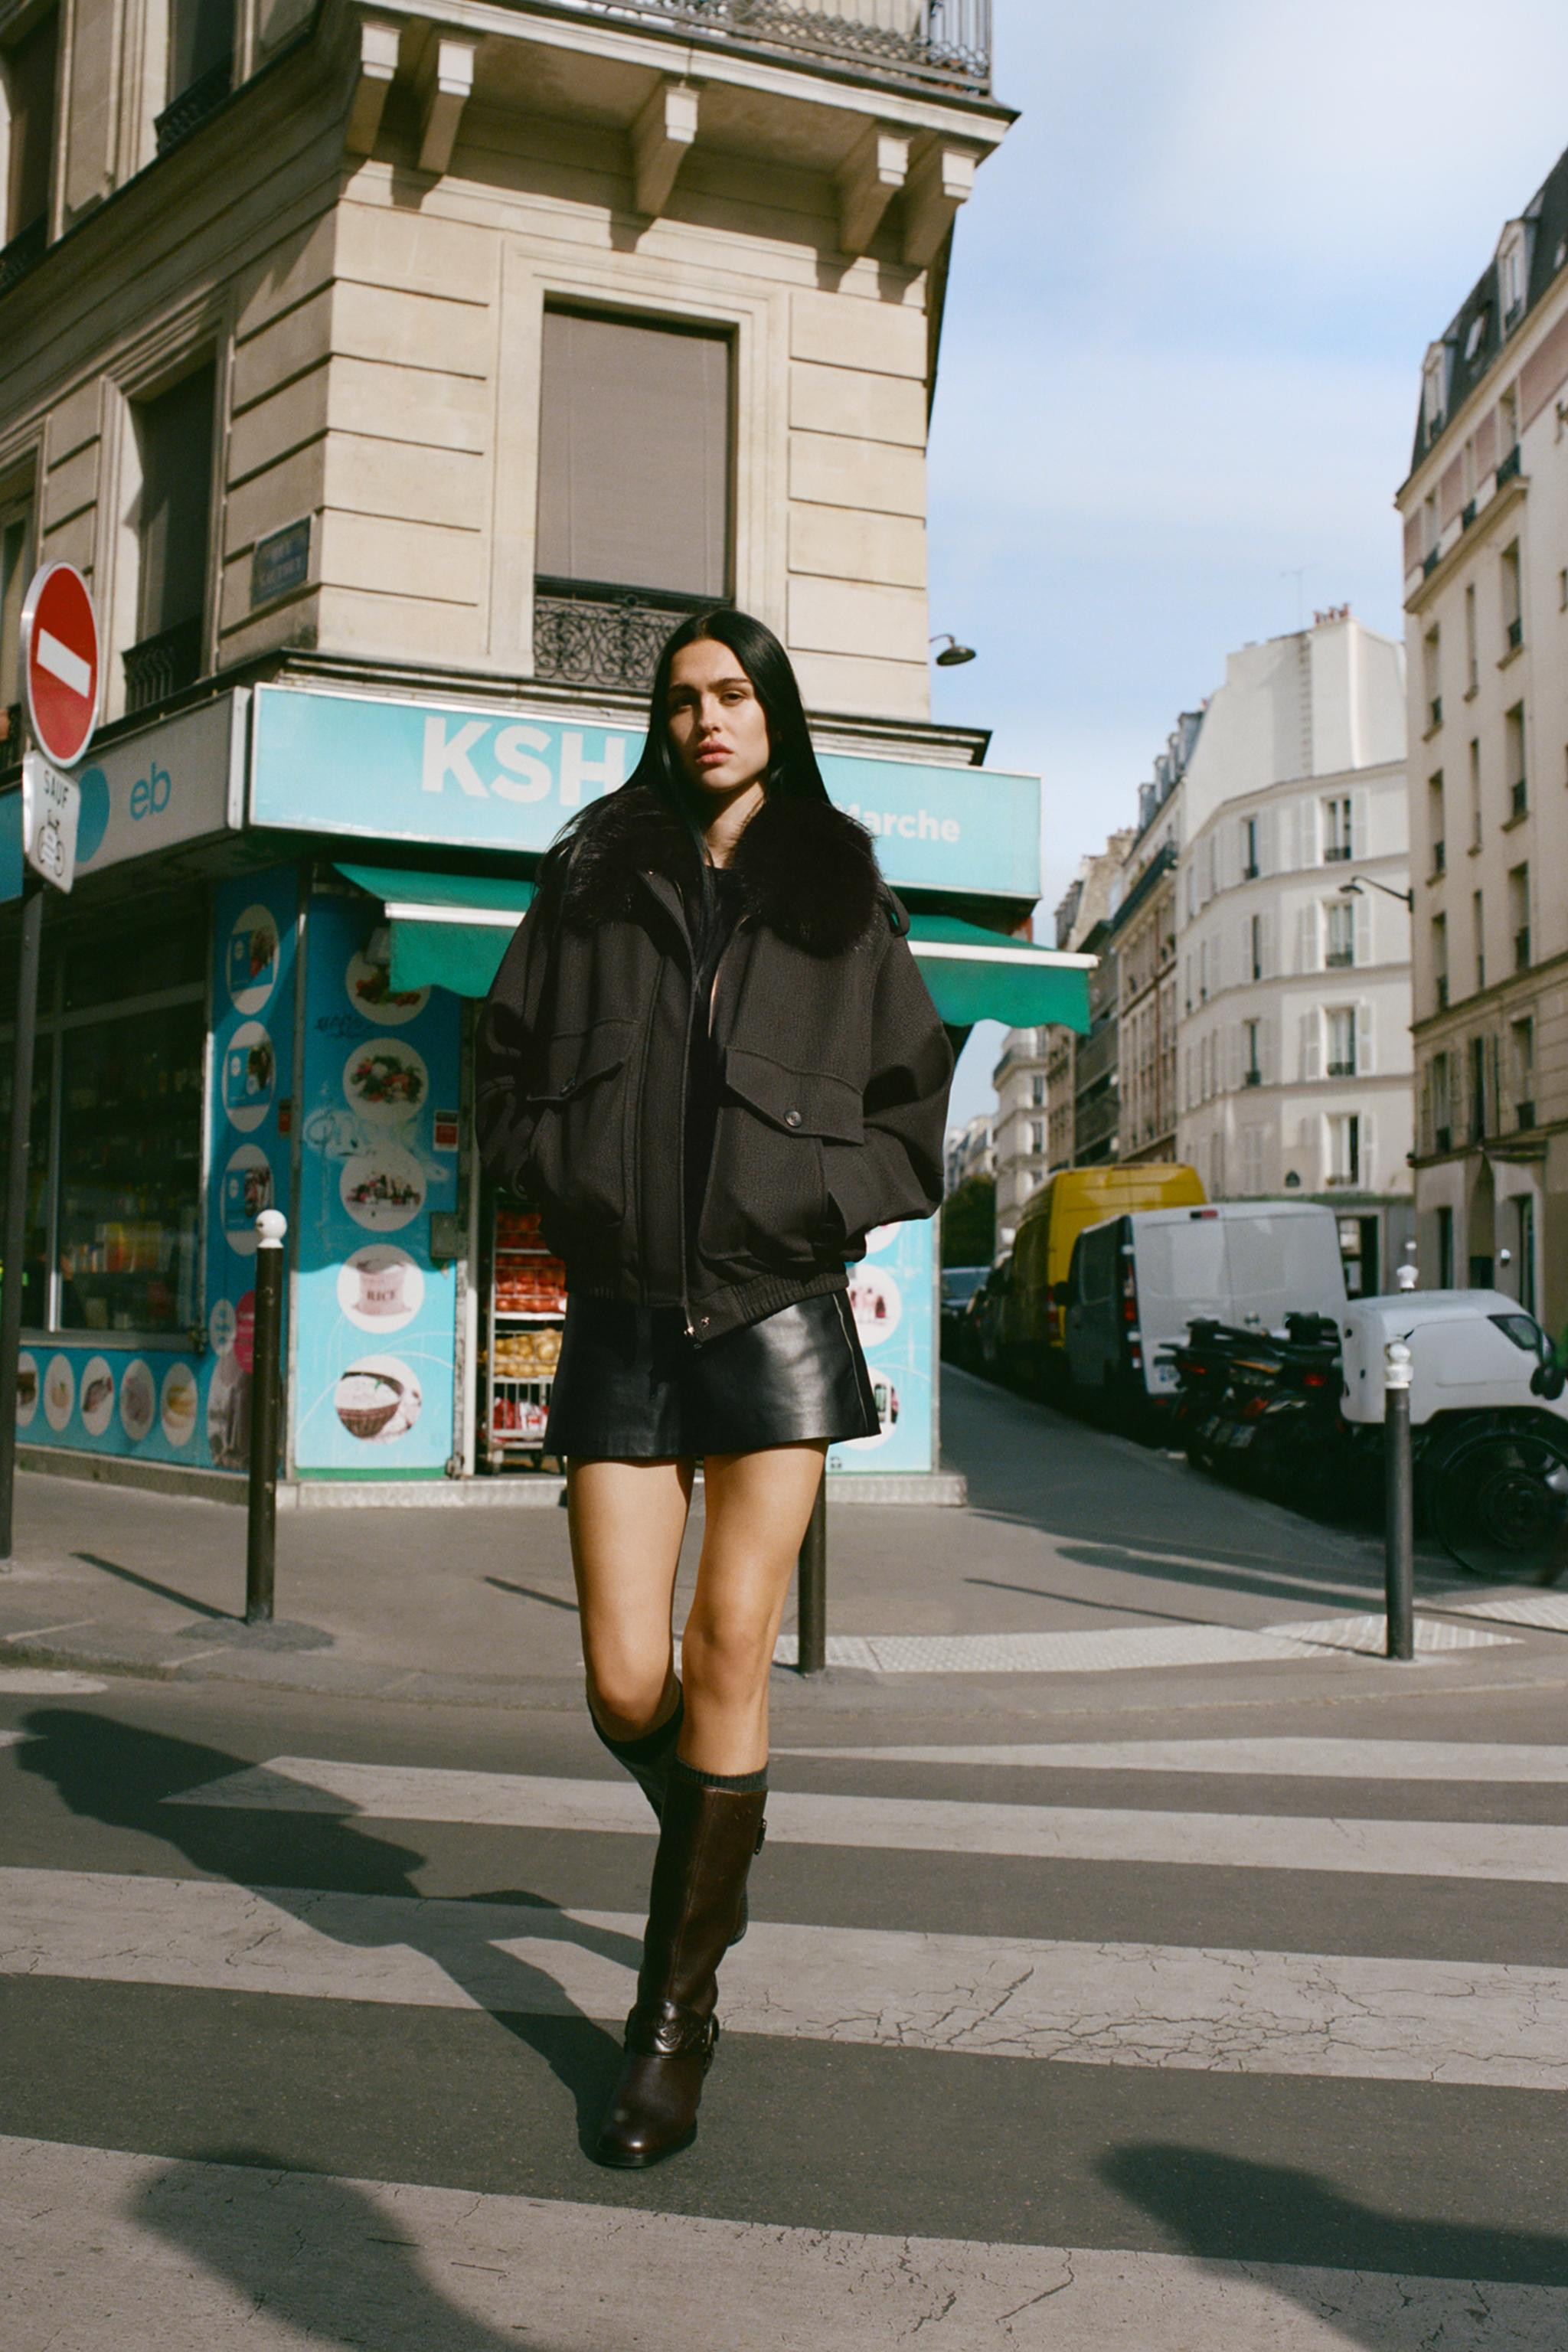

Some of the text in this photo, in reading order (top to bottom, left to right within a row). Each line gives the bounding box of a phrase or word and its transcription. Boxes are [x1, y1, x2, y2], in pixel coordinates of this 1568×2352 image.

[44, 769, 69, 808] SAUF
[129, 760, 172, 821] eb
[422, 716, 626, 806] KSH
